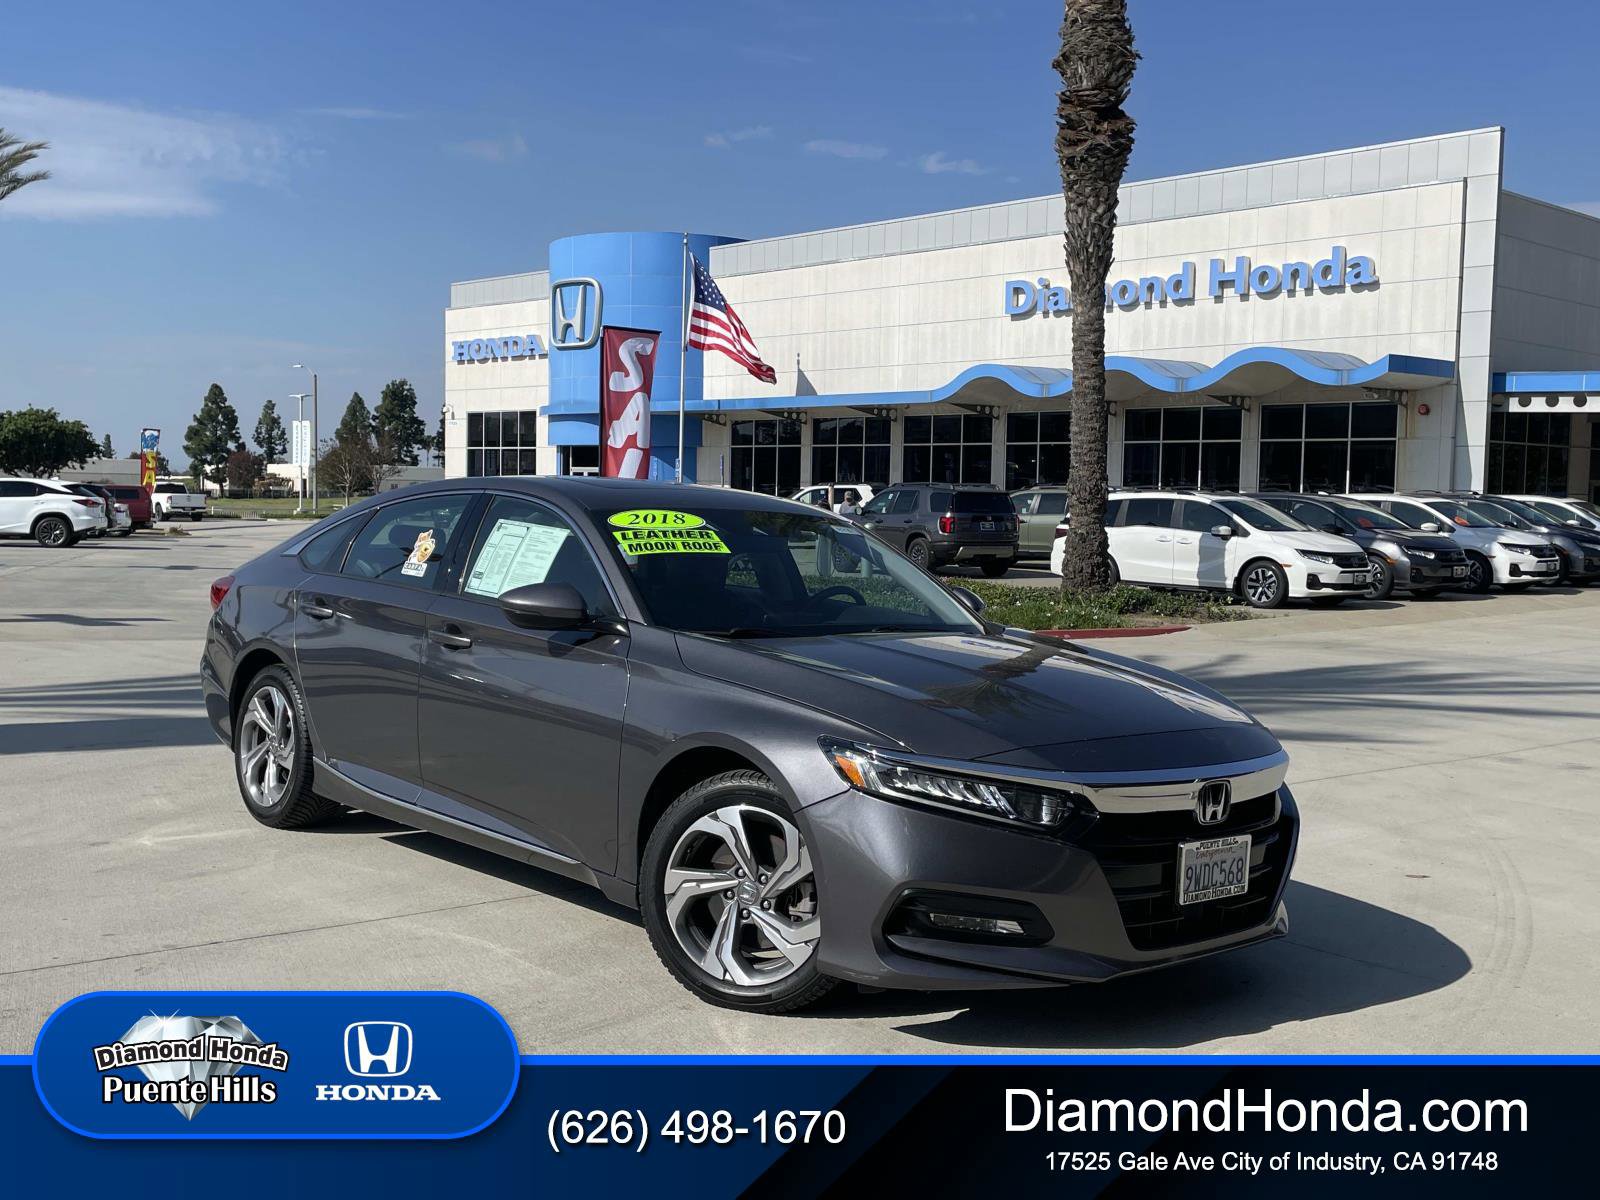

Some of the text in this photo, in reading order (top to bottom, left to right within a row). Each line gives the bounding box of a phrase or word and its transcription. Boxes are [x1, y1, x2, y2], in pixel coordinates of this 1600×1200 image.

[1005, 245, 1377, 315] Diaond Honda
[452, 335, 546, 361] HONDA
[628, 513, 686, 525] 2018
[621, 529, 713, 541] LEATHER
[628, 541, 721, 553] MOON ROOF
[1185, 857, 1244, 892] 9WDC568
